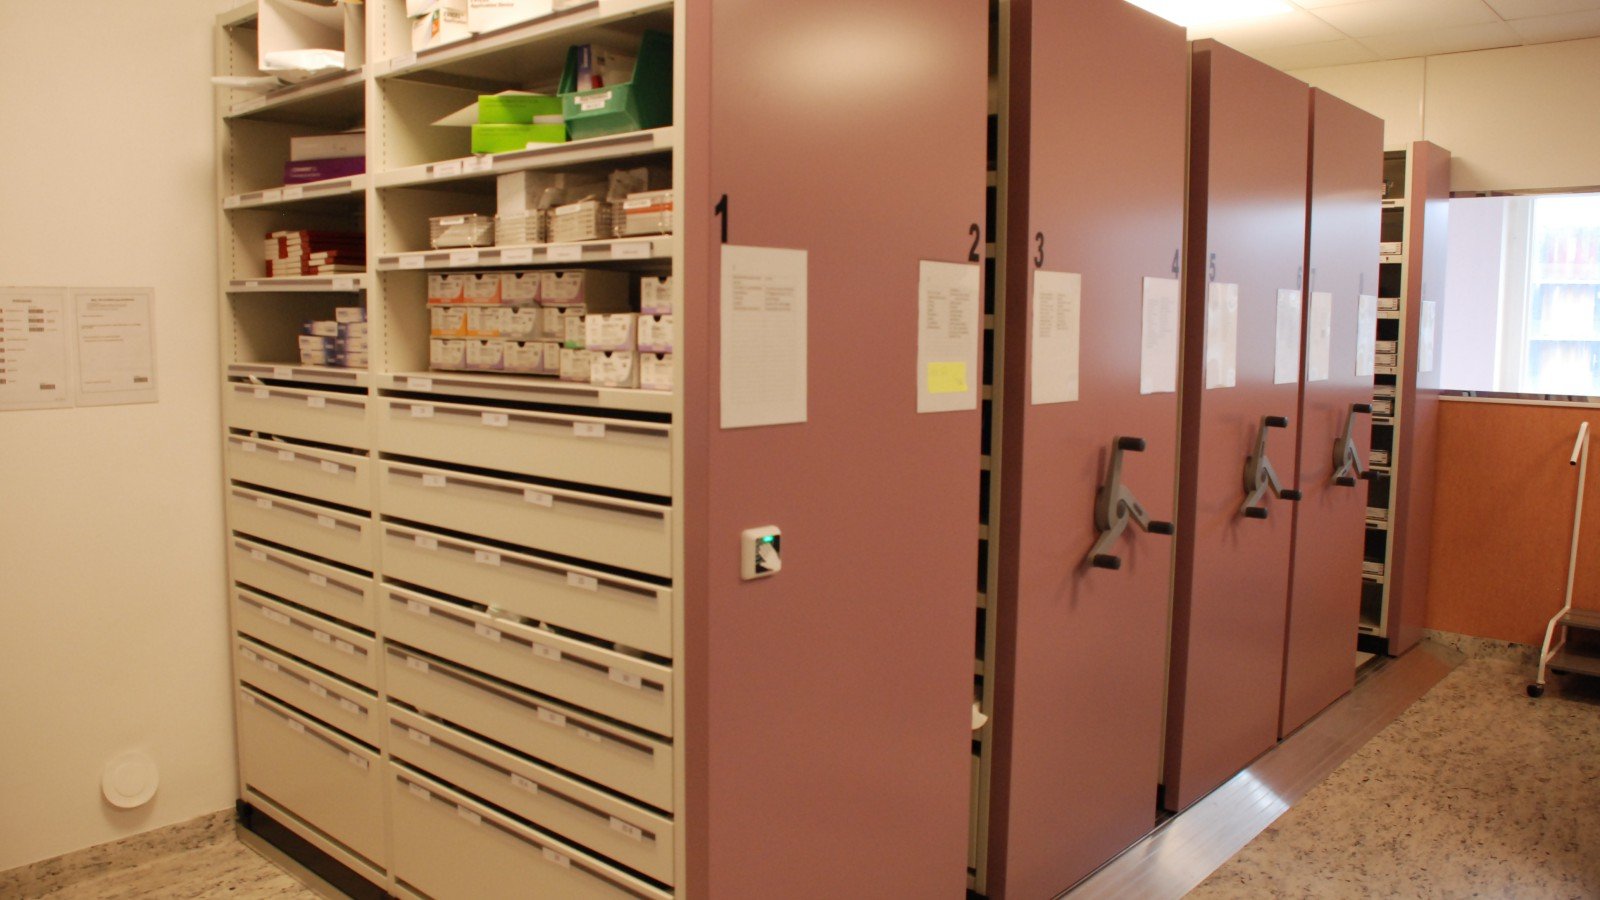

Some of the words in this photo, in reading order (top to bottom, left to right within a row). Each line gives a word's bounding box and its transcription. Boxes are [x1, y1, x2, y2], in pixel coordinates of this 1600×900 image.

[714, 193, 728, 244] 1
[968, 223, 980, 262] 2
[1034, 232, 1044, 268] 3
[1172, 249, 1179, 279] 4
[1209, 253, 1216, 282] 5
